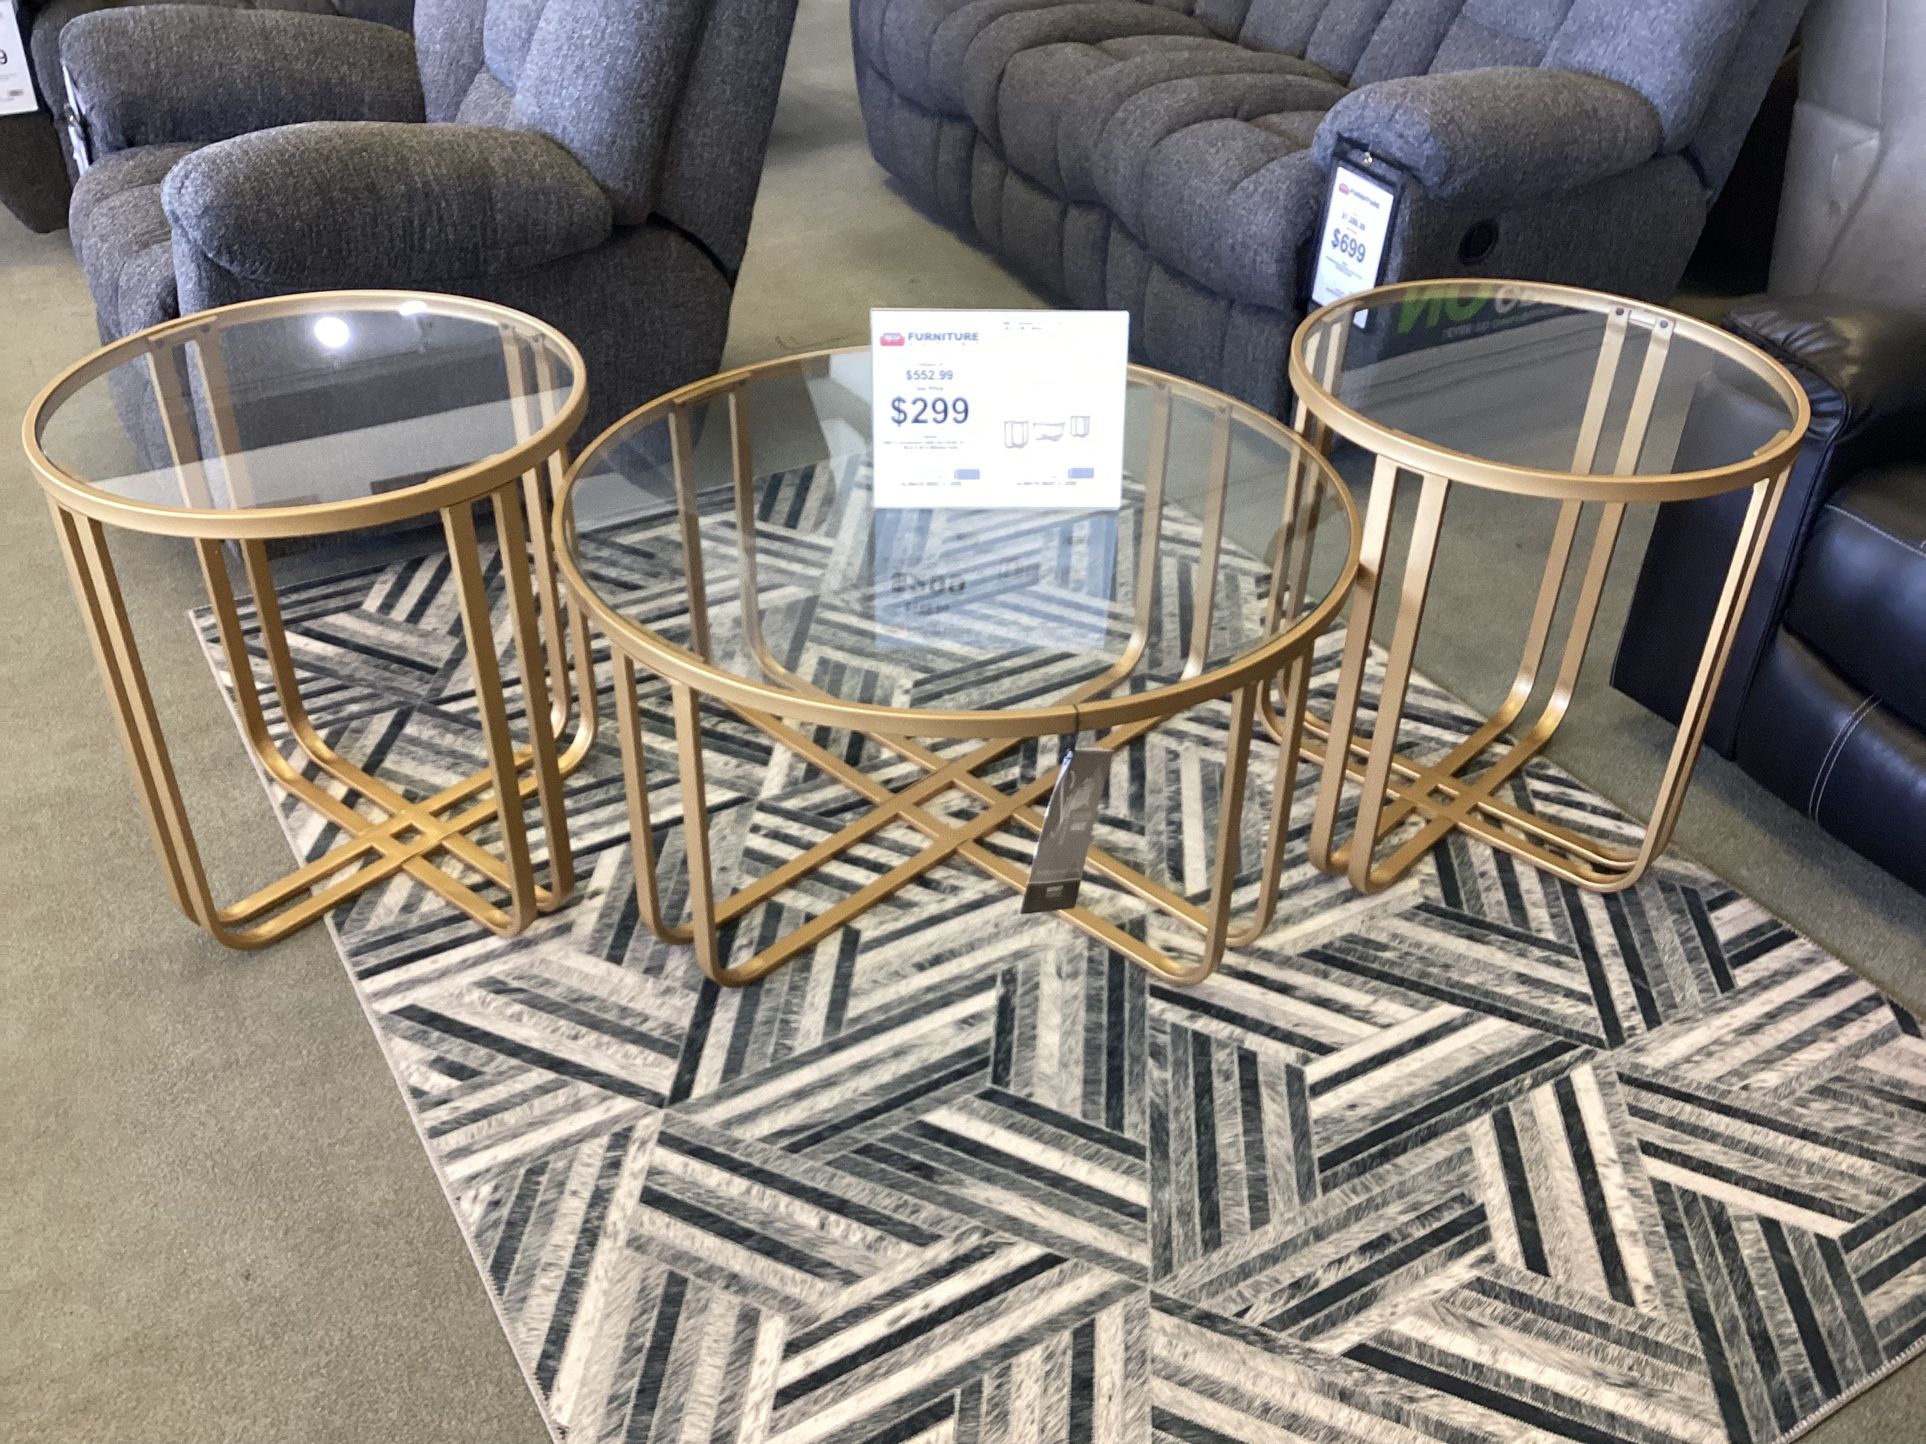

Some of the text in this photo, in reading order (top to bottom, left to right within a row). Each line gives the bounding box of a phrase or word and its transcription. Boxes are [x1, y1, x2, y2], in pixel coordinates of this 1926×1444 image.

[1331, 228, 1367, 263] $699
[907, 332, 979, 341] FURNITURE
[906, 369, 954, 381] $552.99
[891, 396, 969, 428] $299
